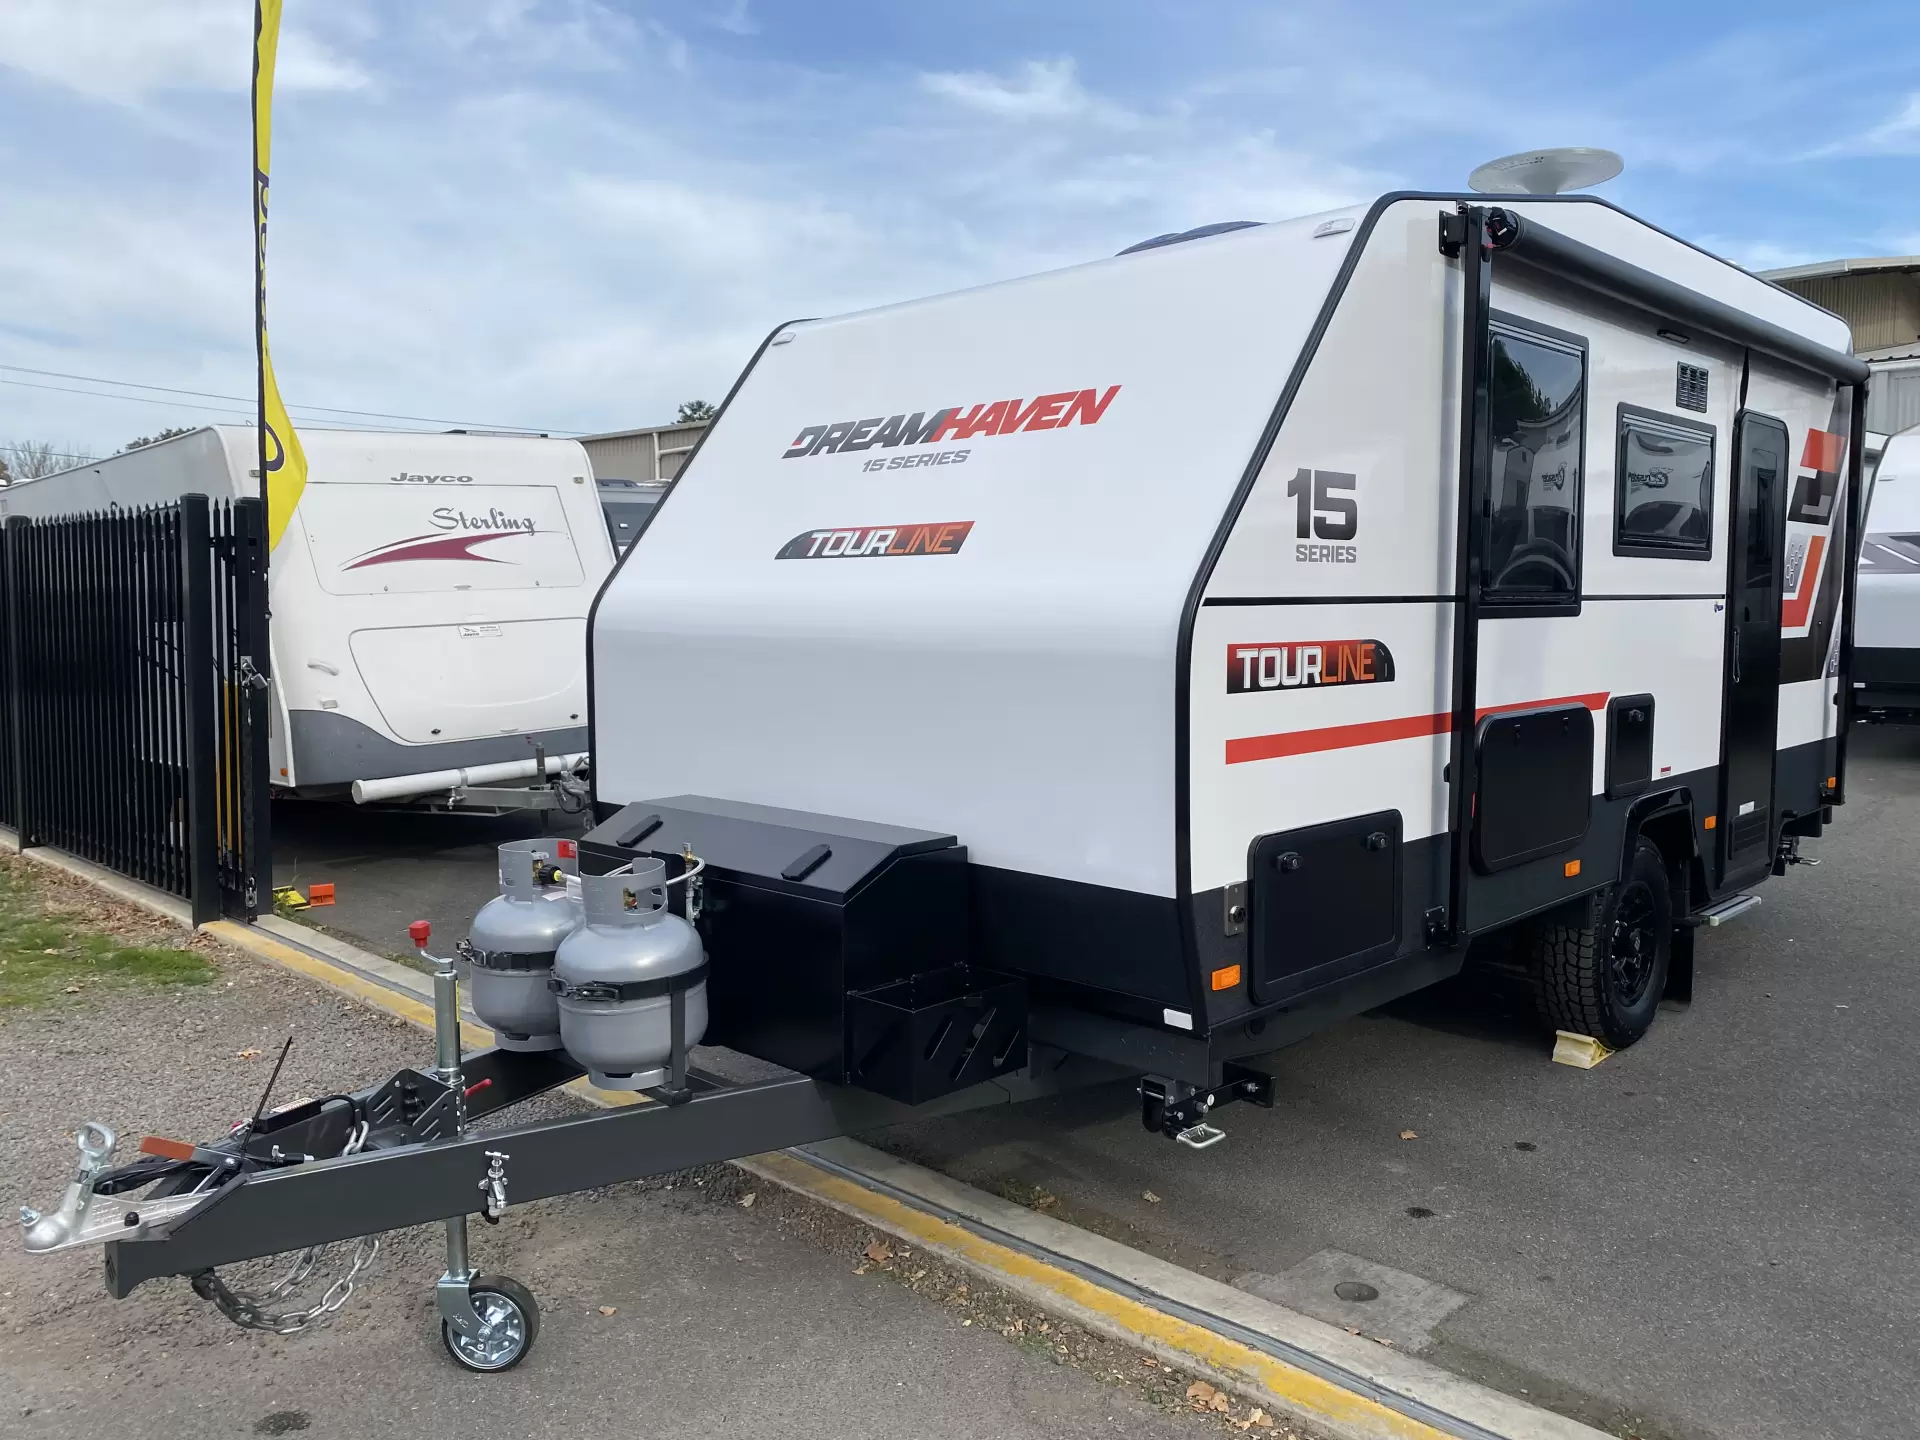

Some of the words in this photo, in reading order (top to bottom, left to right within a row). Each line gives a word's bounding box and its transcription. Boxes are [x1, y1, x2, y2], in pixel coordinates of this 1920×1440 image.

[781, 384, 1123, 459] DREAMHAVEN
[862, 458, 886, 473] 15
[886, 449, 972, 471] SERIES
[390, 472, 474, 484] Jayco
[1287, 467, 1358, 541] 15
[428, 507, 536, 536] Sterling
[807, 524, 963, 556] TOURLINE
[1295, 544, 1357, 564] SERIES
[1236, 644, 1376, 688] TOURLINE
